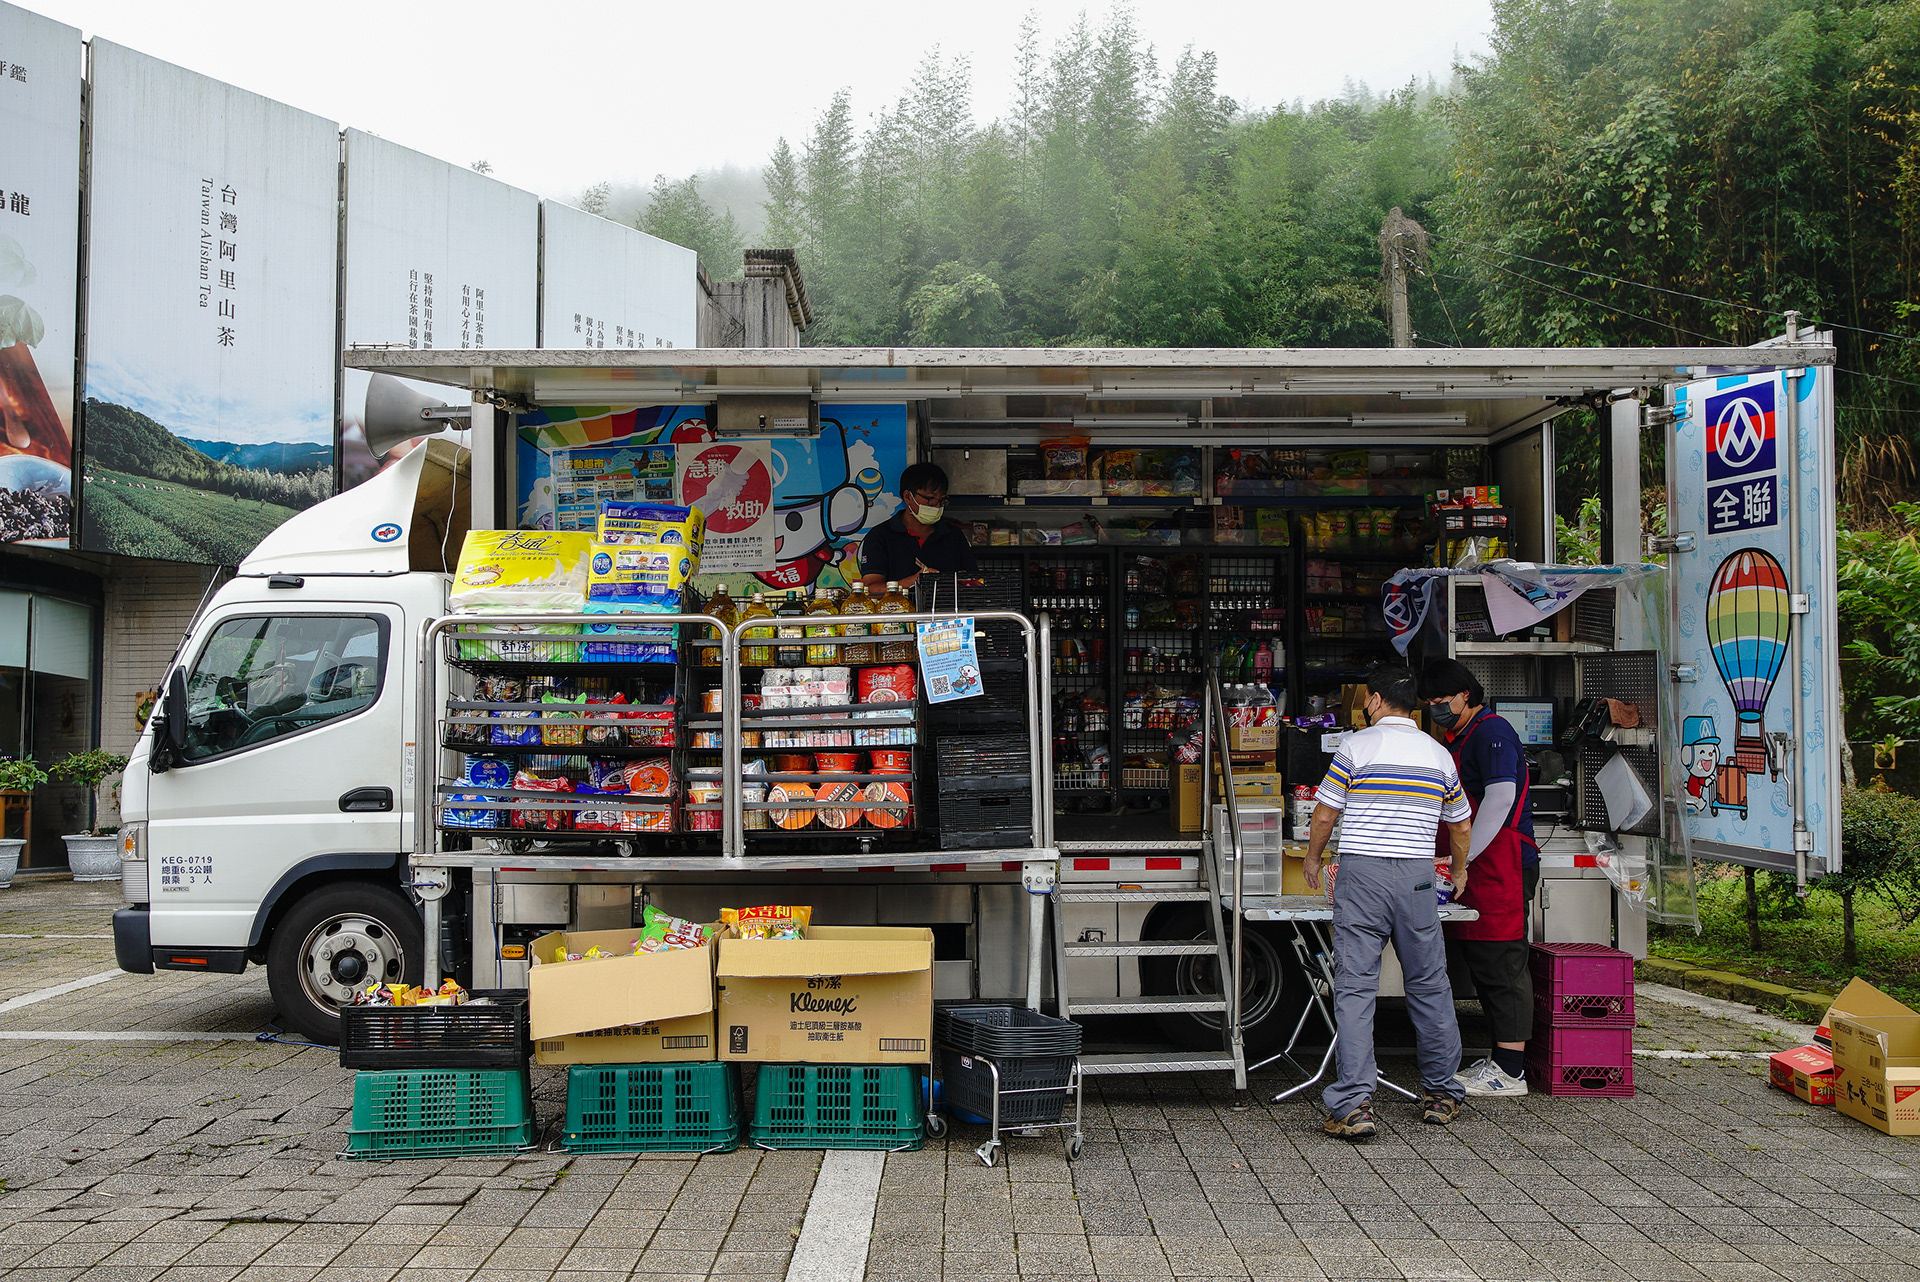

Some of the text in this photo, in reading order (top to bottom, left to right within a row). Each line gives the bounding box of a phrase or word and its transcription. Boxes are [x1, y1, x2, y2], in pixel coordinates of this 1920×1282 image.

[199, 177, 214, 308] Taiwan Alishan Tea
[217, 184, 237, 347] 台灣阿里山茶
[585, 316, 594, 349] 親力親
[688, 458, 727, 479] 急難
[725, 499, 764, 521] 救助
[1713, 480, 1771, 529] 全聯
[771, 566, 800, 584] 福
[162, 856, 213, 864] KEG-0719
[204, 875, 212, 884] 人
[806, 976, 842, 990] 舒潔
[790, 992, 858, 1016] Kleenex
